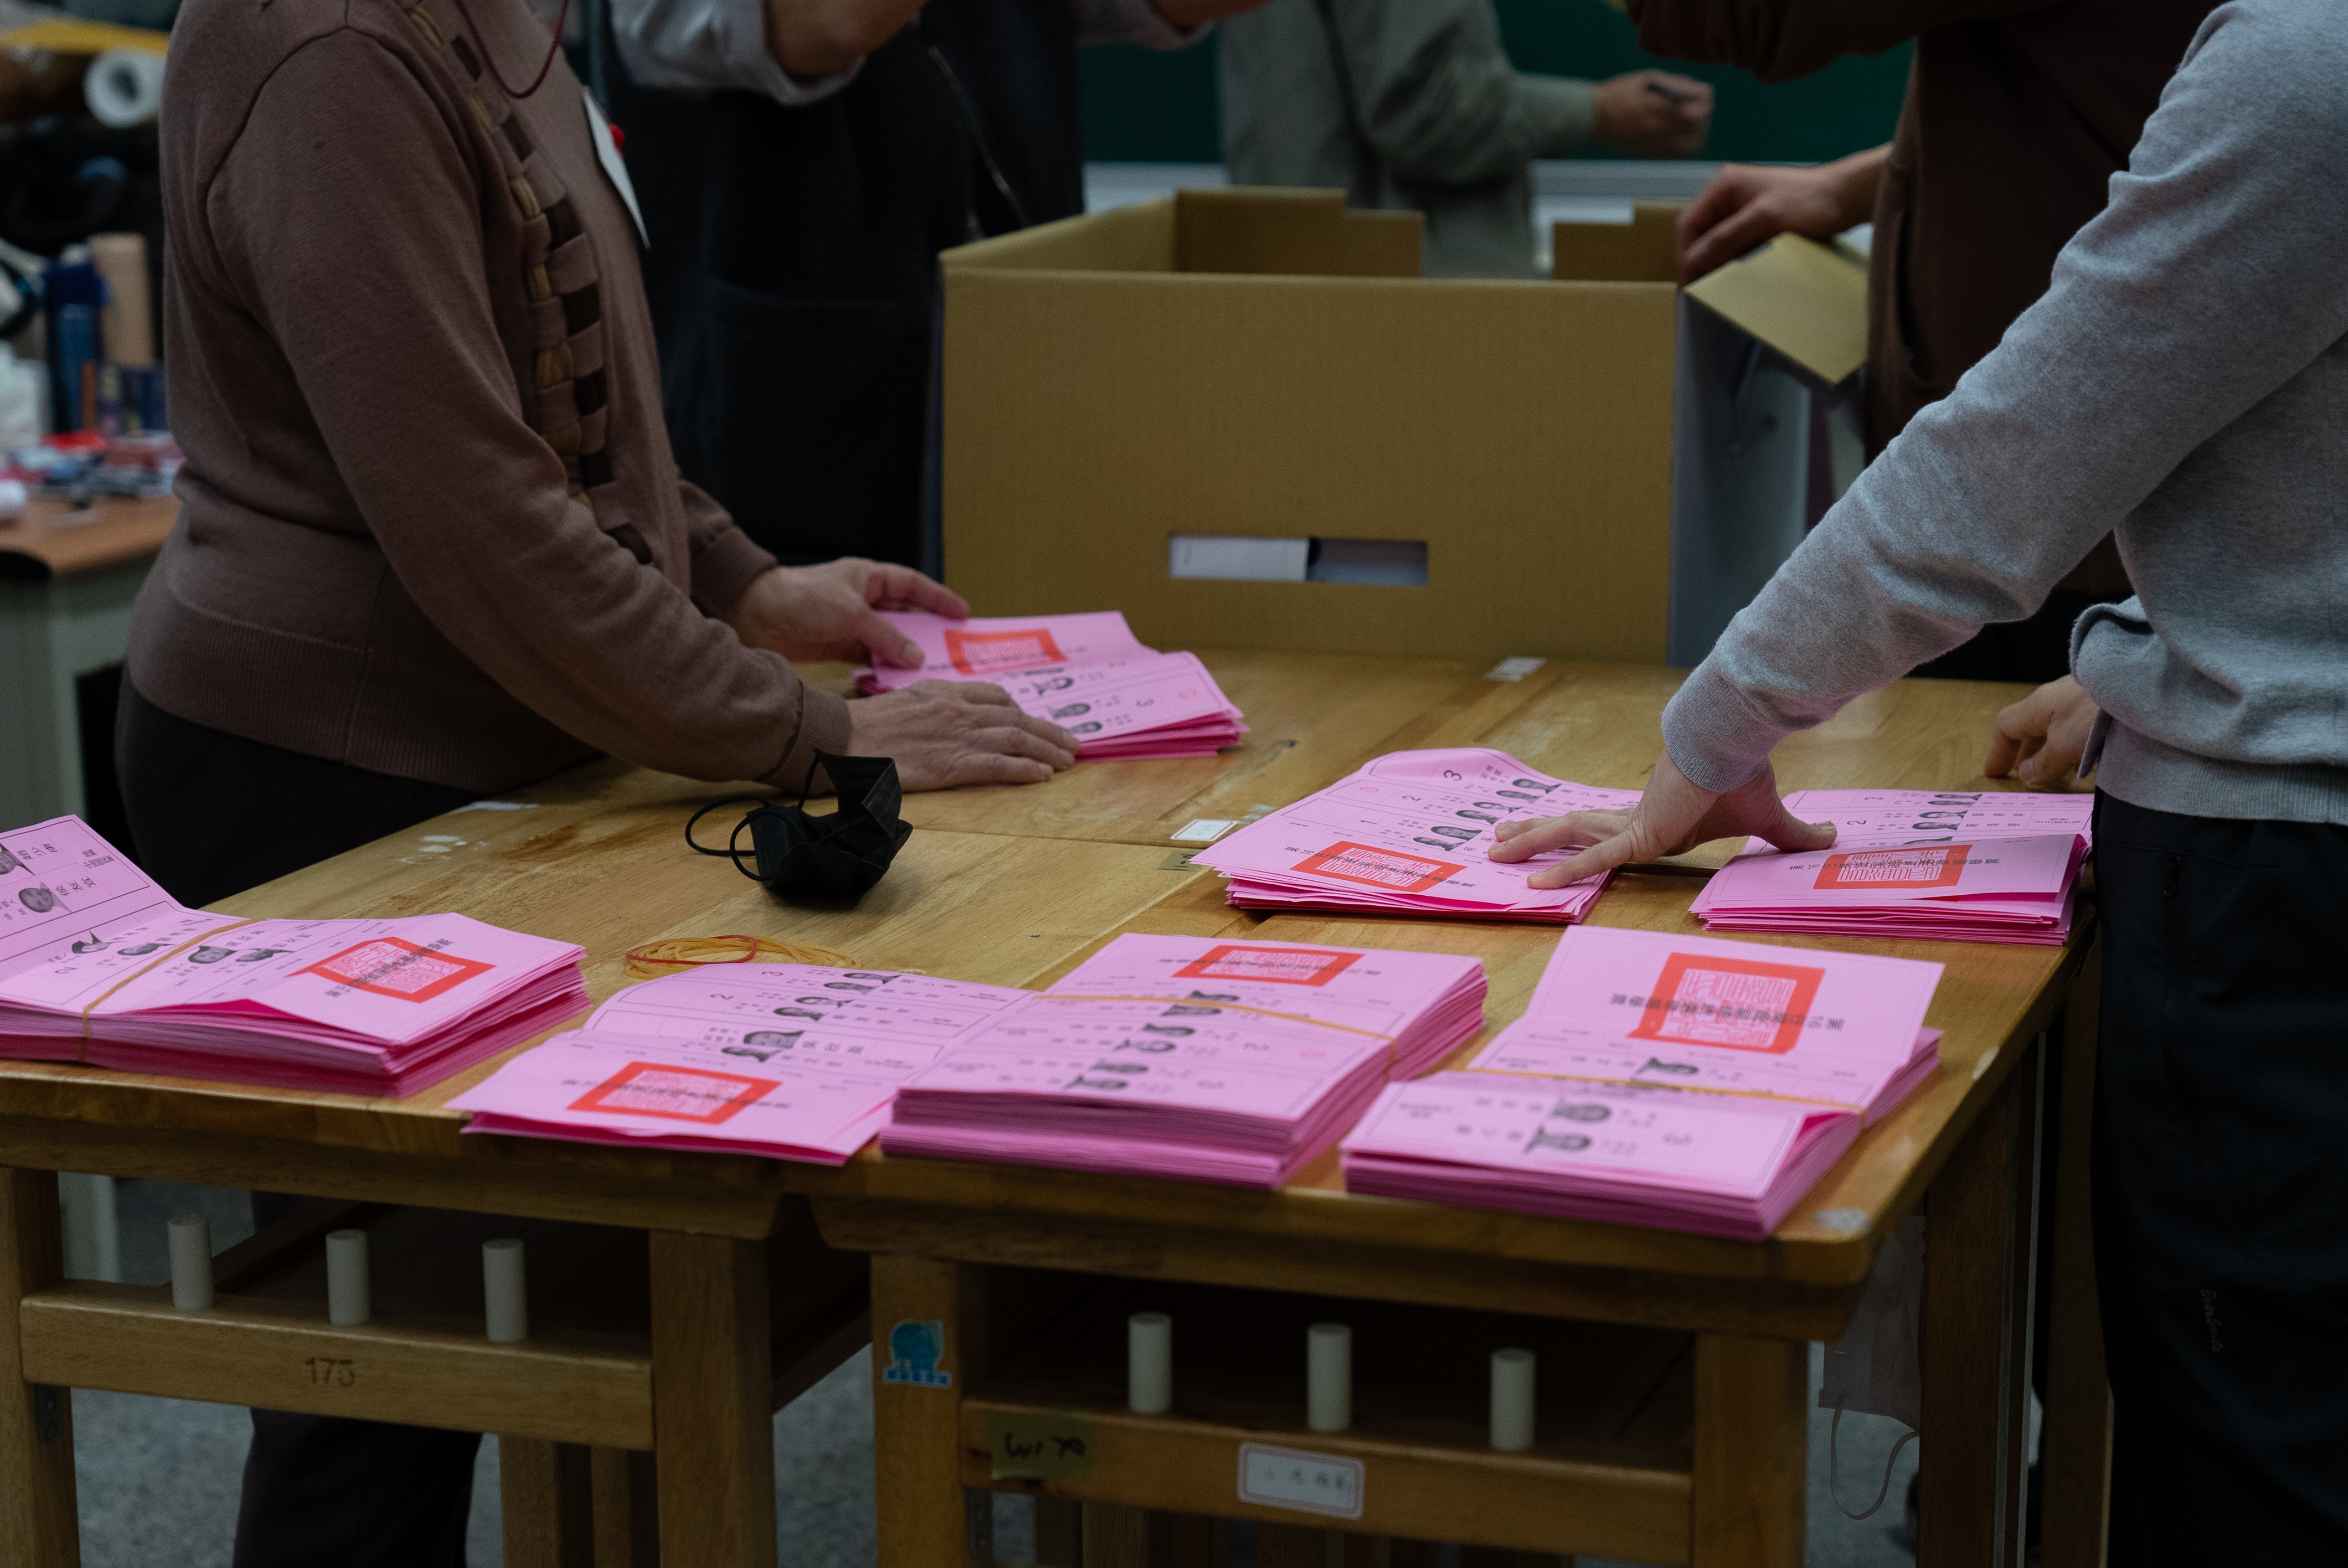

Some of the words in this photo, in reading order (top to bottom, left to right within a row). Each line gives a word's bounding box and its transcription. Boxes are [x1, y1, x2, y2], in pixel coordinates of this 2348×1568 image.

[1444, 770, 1461, 781] 3
[56, 876, 96, 896] 侯友宜
